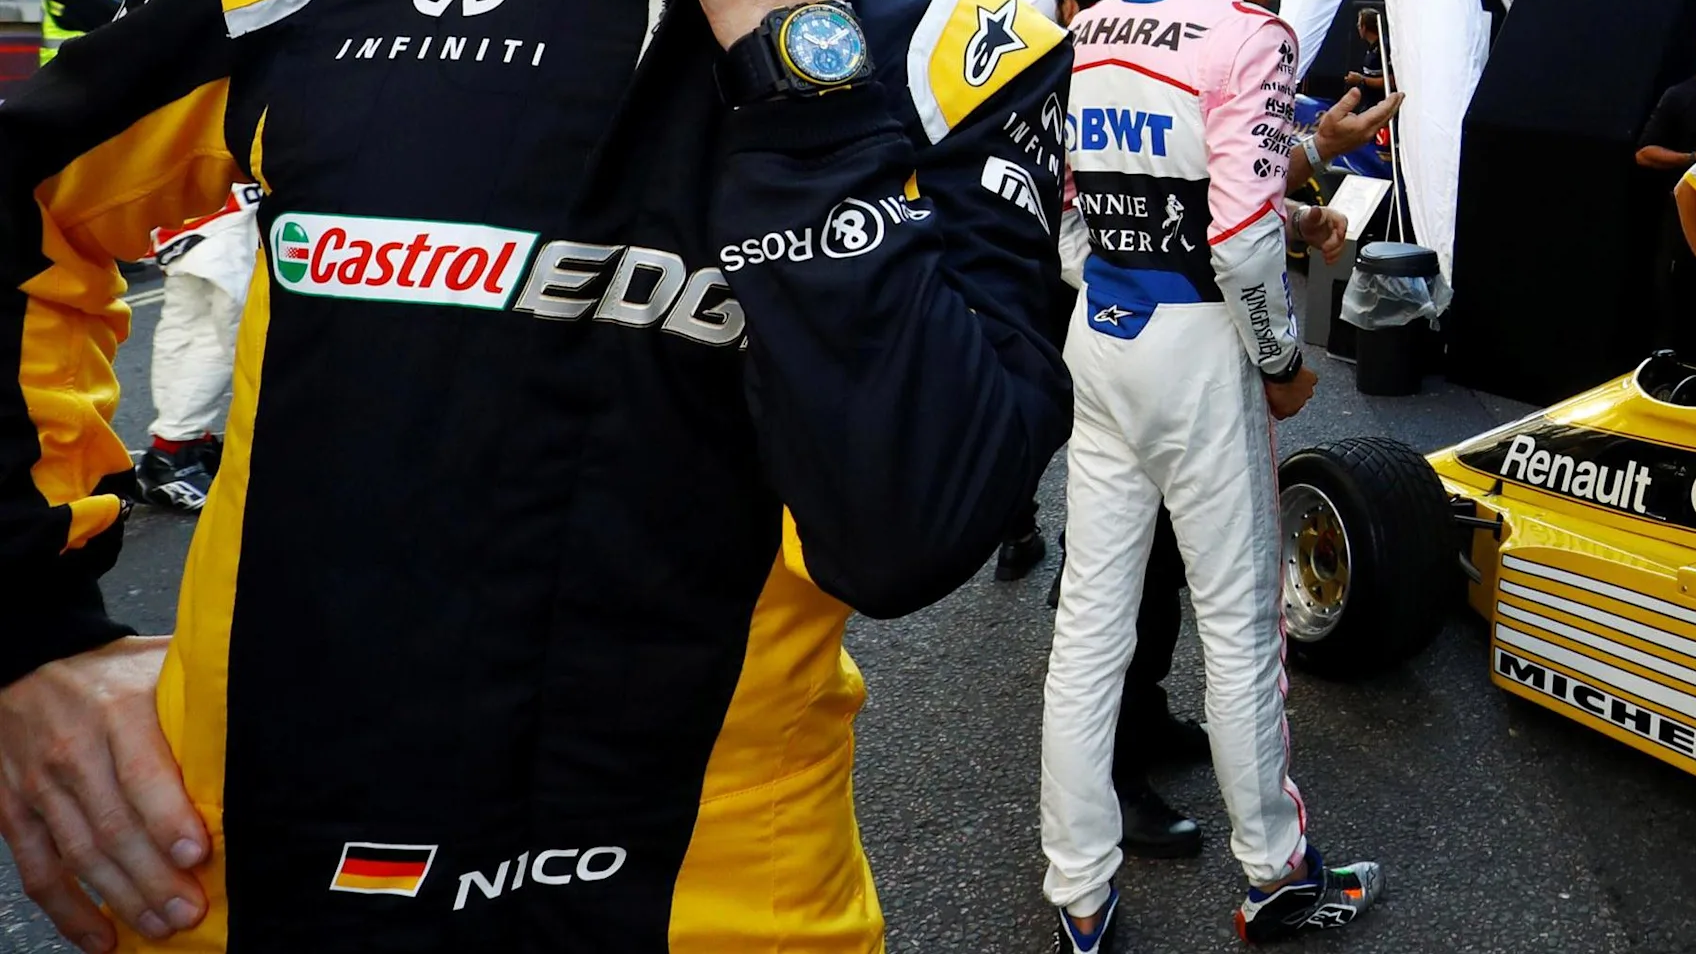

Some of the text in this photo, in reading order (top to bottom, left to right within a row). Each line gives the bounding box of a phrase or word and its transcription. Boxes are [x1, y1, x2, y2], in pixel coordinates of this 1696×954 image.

[336, 36, 546, 67] INFINITI
[1003, 112, 1061, 197] INFIN
[1082, 108, 1173, 157] BWT
[1252, 124, 1295, 146] QUAKE
[1080, 192, 1148, 217] NNIE
[720, 228, 813, 272] Ross
[1091, 229, 1154, 252] KER
[311, 227, 747, 349] Castrol EDG
[1241, 282, 1281, 364] KINGFISHER
[1500, 434, 1652, 513] Renault
[453, 846, 627, 911] NICO
